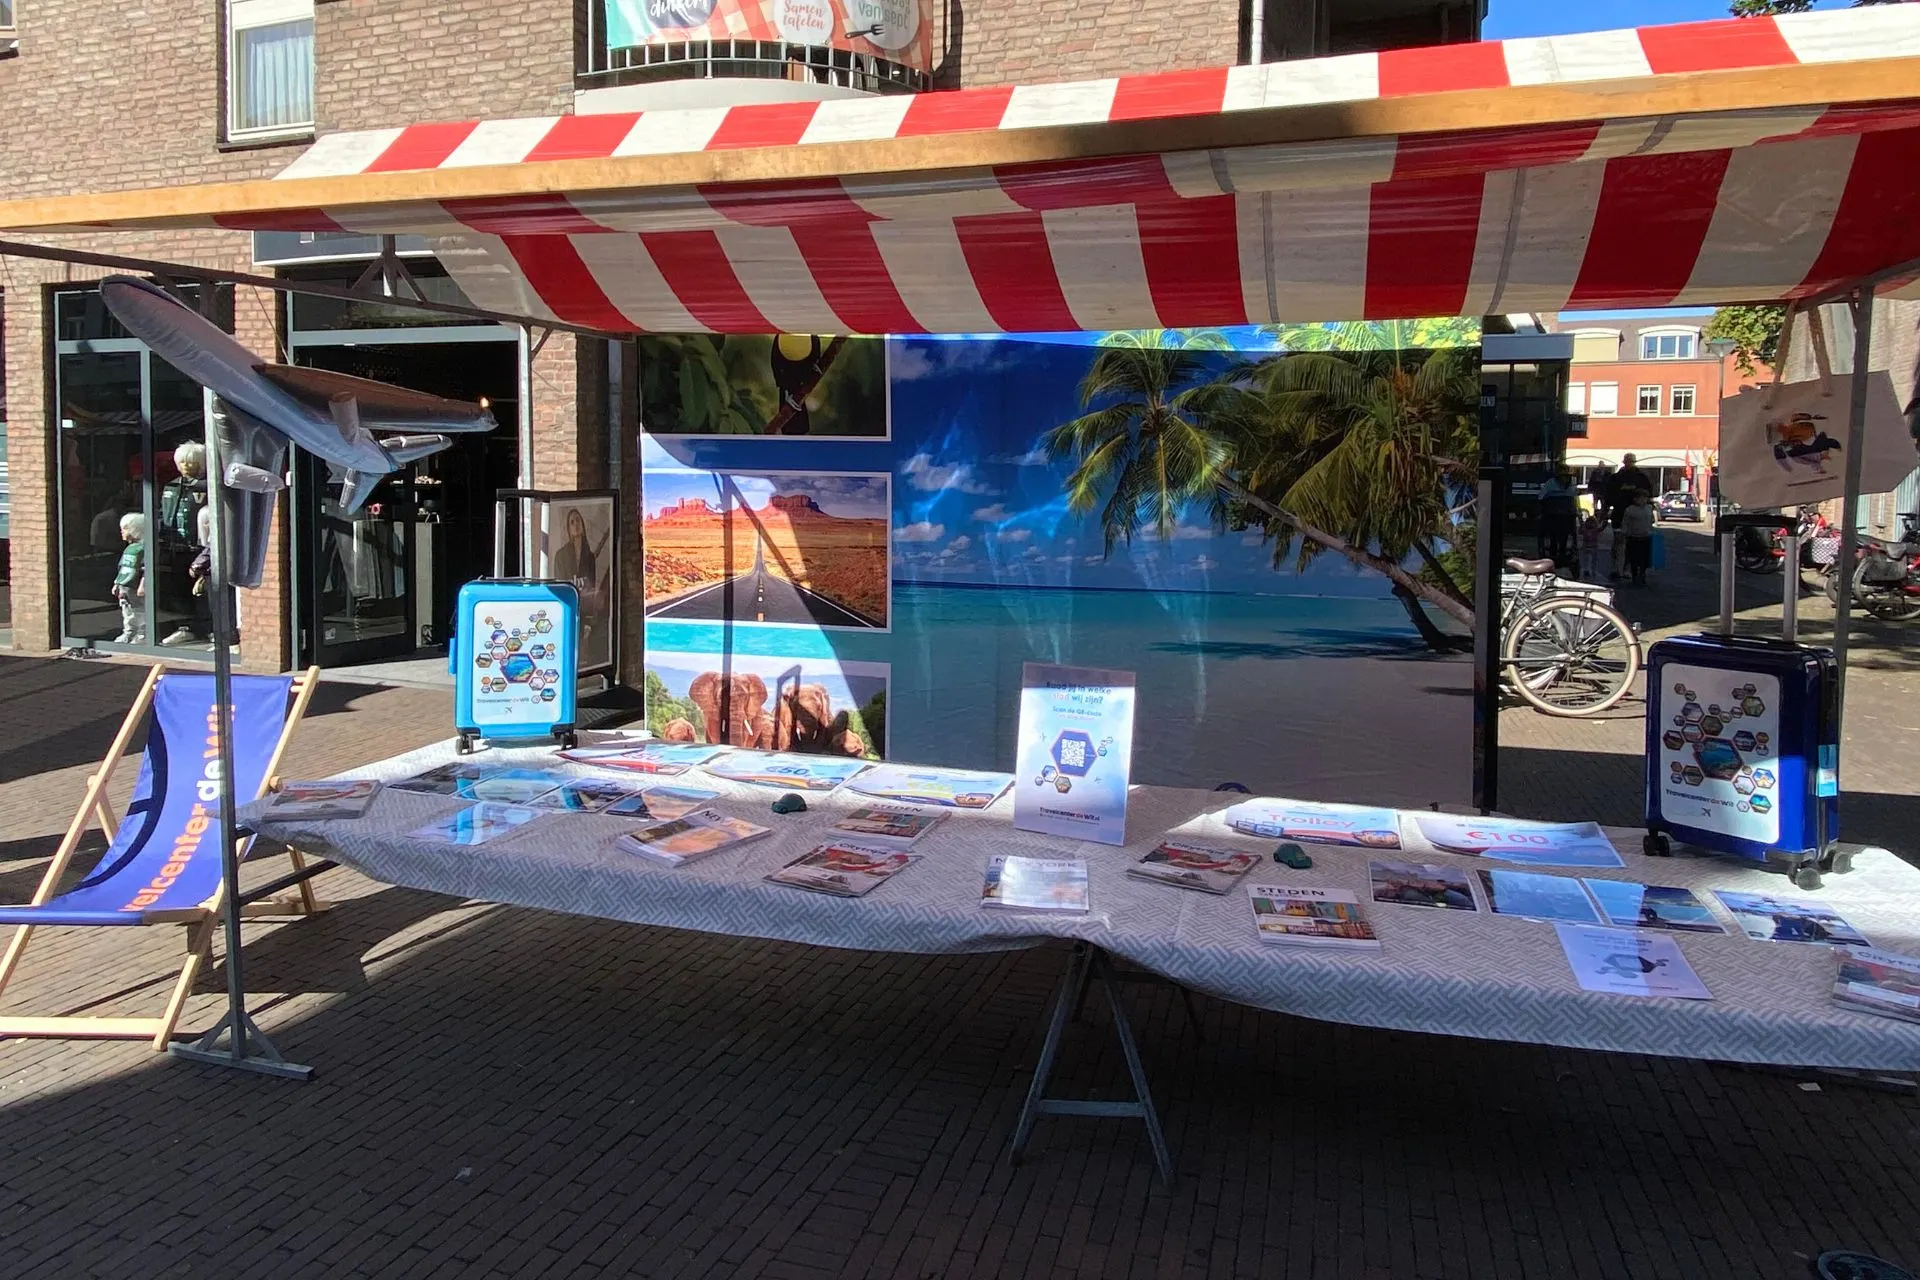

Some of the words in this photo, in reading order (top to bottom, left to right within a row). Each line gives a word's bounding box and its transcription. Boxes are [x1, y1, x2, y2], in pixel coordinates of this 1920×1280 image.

[784, 0, 822, 18] Samen
[858, 2, 881, 20] van
[1269, 813, 1356, 829] Trolley
[1466, 830, 1550, 845] €100
[1256, 887, 1326, 897] STEDEN
